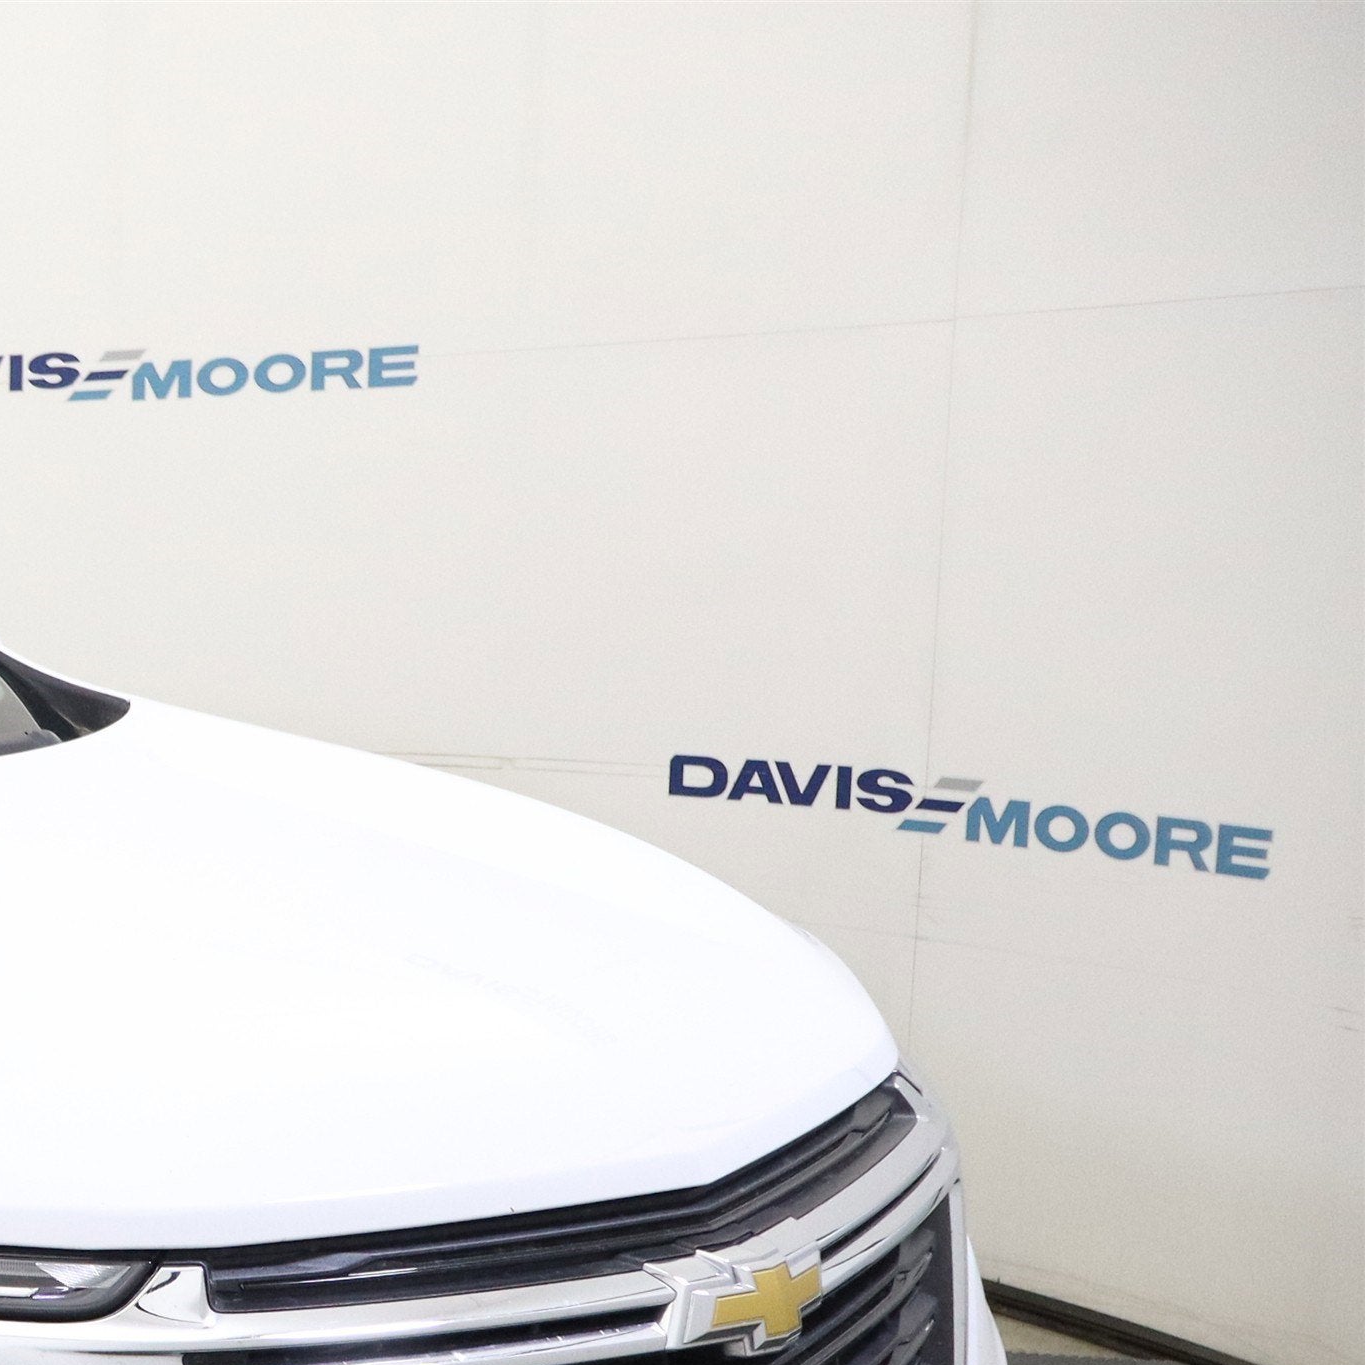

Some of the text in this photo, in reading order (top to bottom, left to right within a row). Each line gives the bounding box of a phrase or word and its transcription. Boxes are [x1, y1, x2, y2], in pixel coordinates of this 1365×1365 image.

[131, 344, 420, 402] MOORE
[668, 753, 1274, 881] DAVIS MOORE
